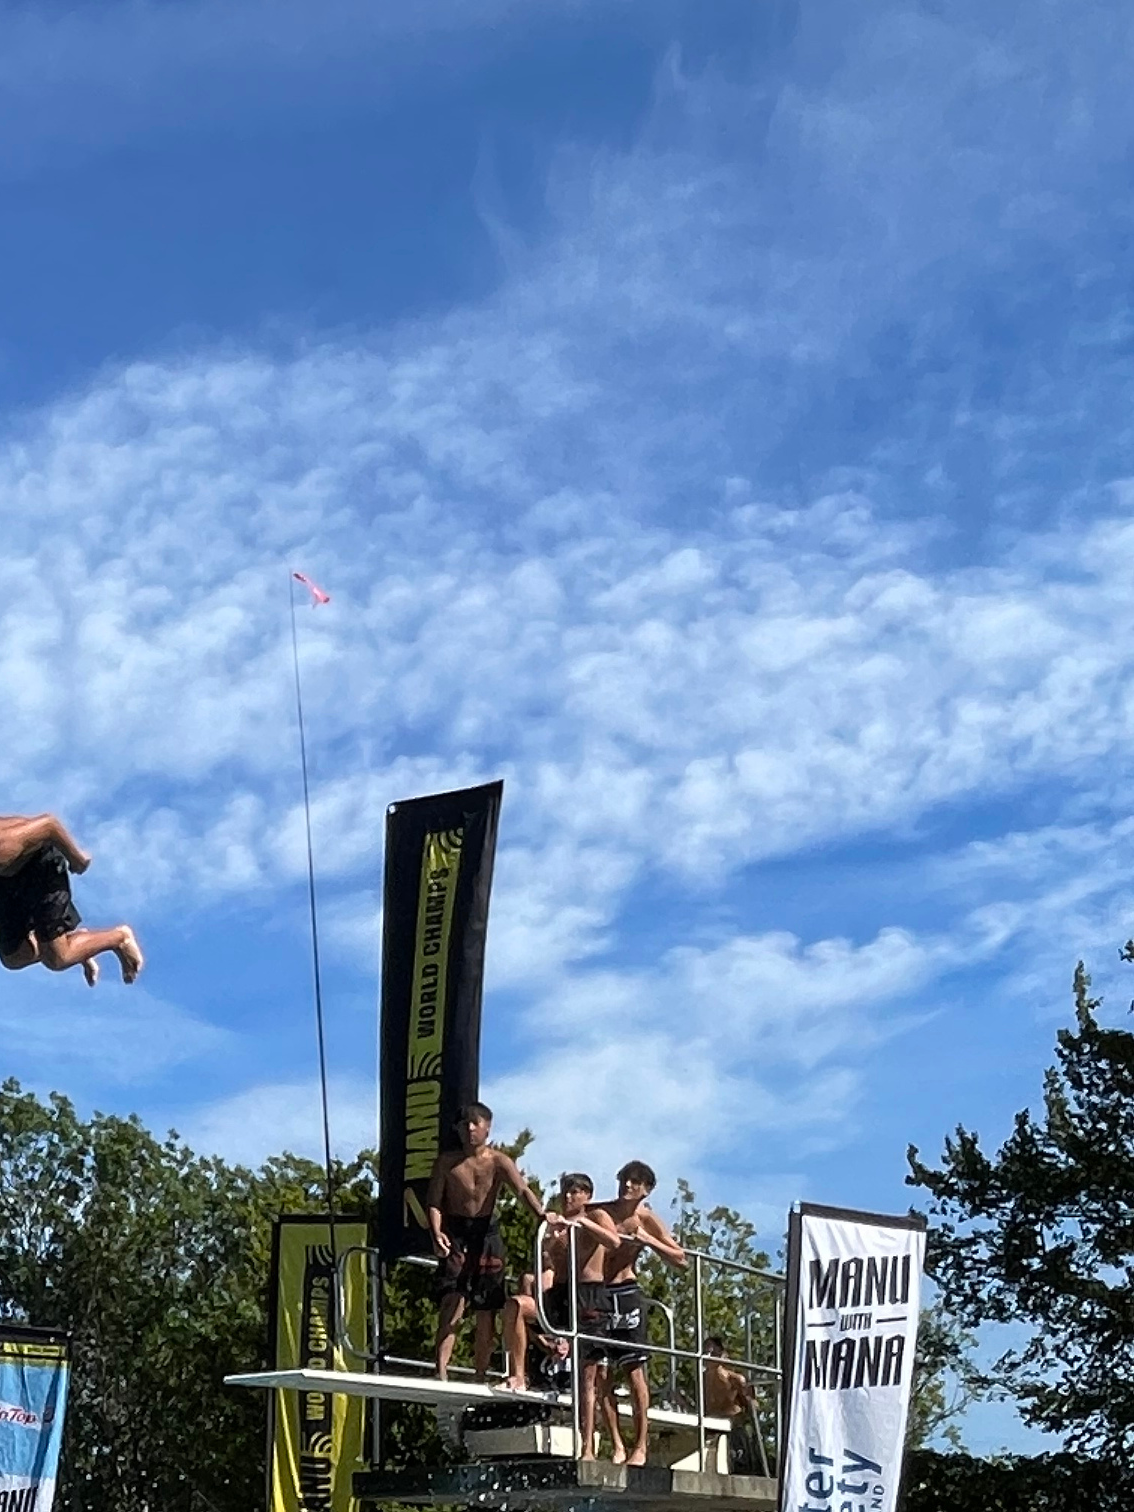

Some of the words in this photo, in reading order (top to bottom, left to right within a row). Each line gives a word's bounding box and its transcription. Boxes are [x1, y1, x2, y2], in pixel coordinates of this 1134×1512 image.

[423, 867, 450, 957] CHAMPS
[417, 963, 439, 1040] WORLD
[404, 1080, 443, 1181] MANU
[307, 1276, 330, 1352] CHAMPS
[808, 1254, 911, 1309] MANU
[306, 1357, 327, 1421] WOD
